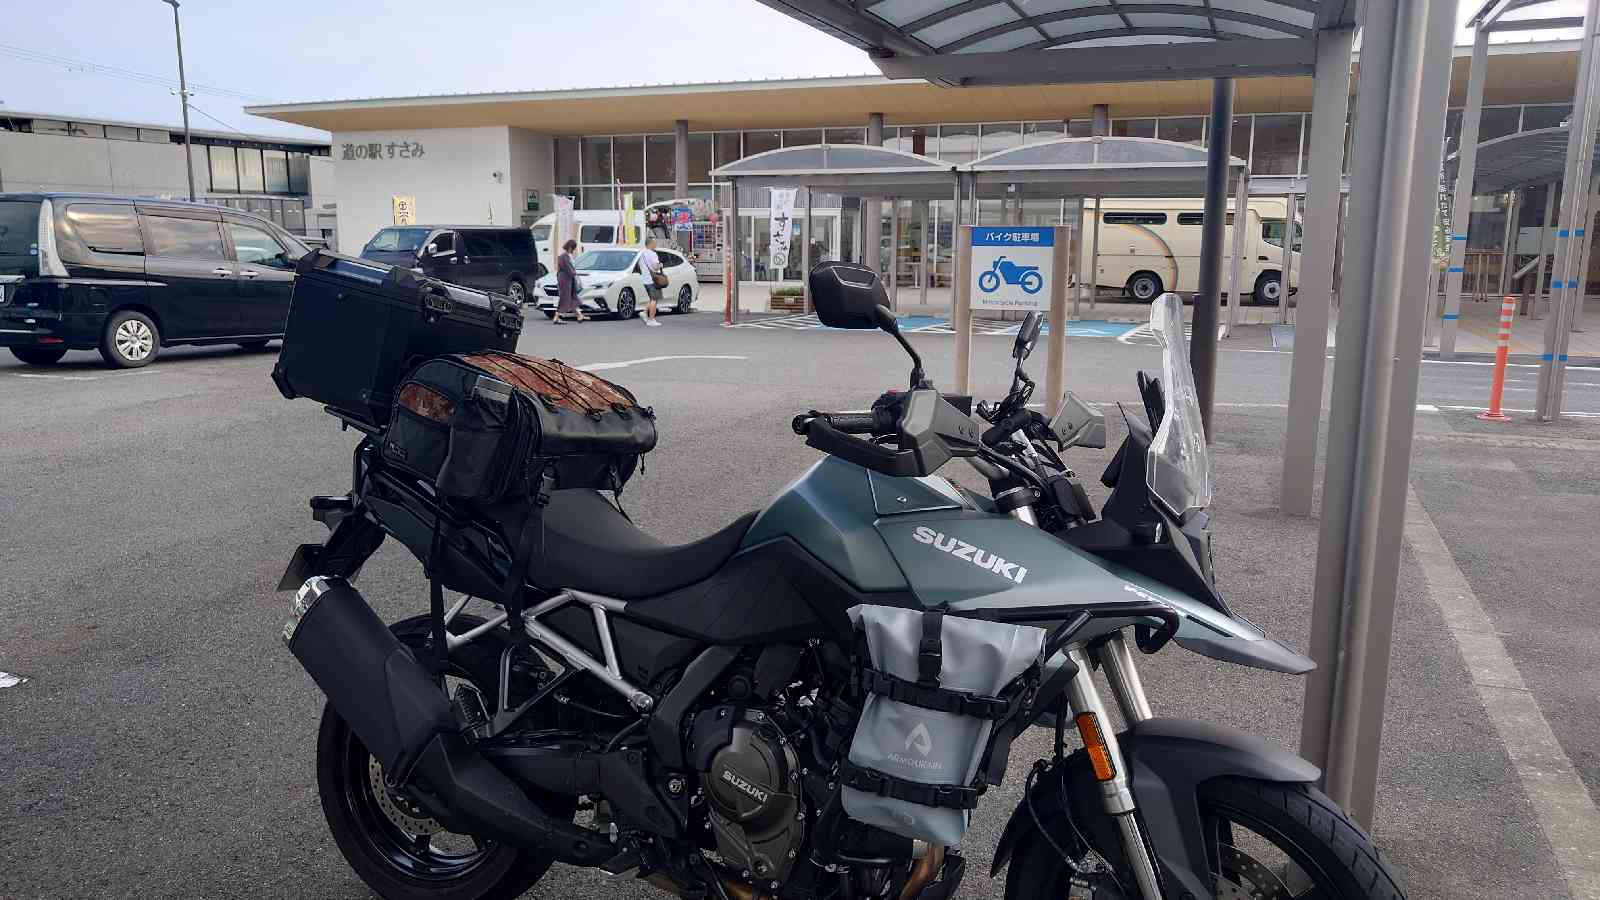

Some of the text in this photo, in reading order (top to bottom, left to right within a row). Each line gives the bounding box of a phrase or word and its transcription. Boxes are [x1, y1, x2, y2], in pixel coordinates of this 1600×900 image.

[342, 141, 425, 161] 道の駅 すさみ
[912, 525, 1028, 584] SUZUKI
[722, 770, 768, 802] SUZUKI
